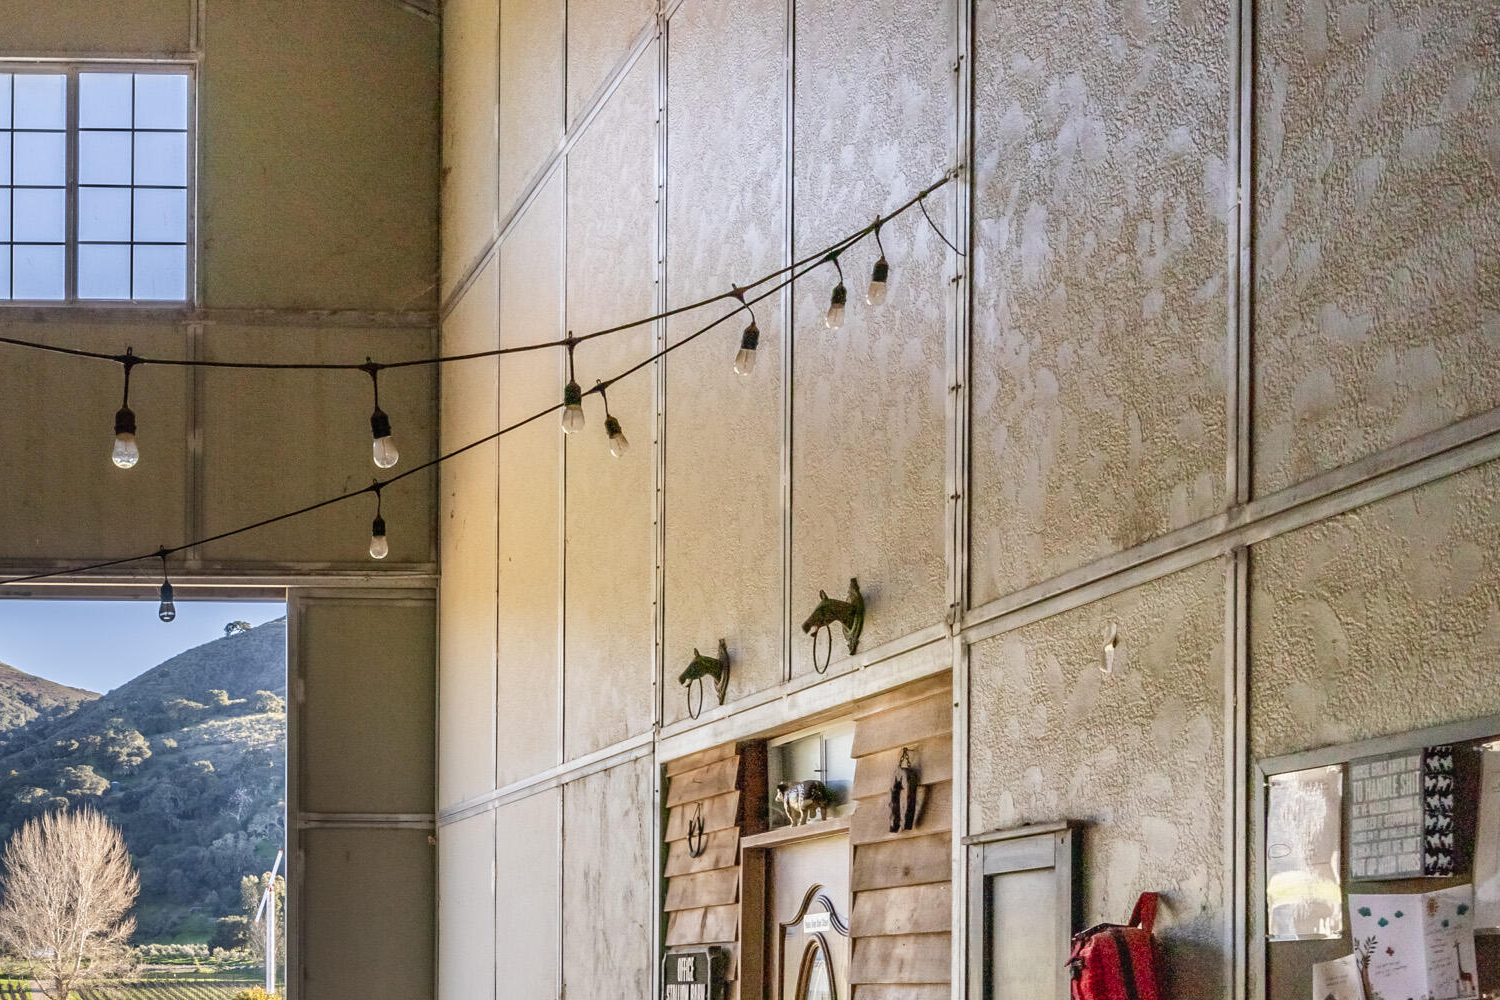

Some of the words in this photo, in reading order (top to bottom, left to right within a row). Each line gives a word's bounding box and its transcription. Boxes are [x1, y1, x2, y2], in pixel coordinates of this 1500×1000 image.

[1352, 780, 1364, 803] TO
[1365, 774, 1399, 802] HANDLE
[1400, 771, 1421, 797] SHIT
[677, 957, 694, 981] OFFICE
